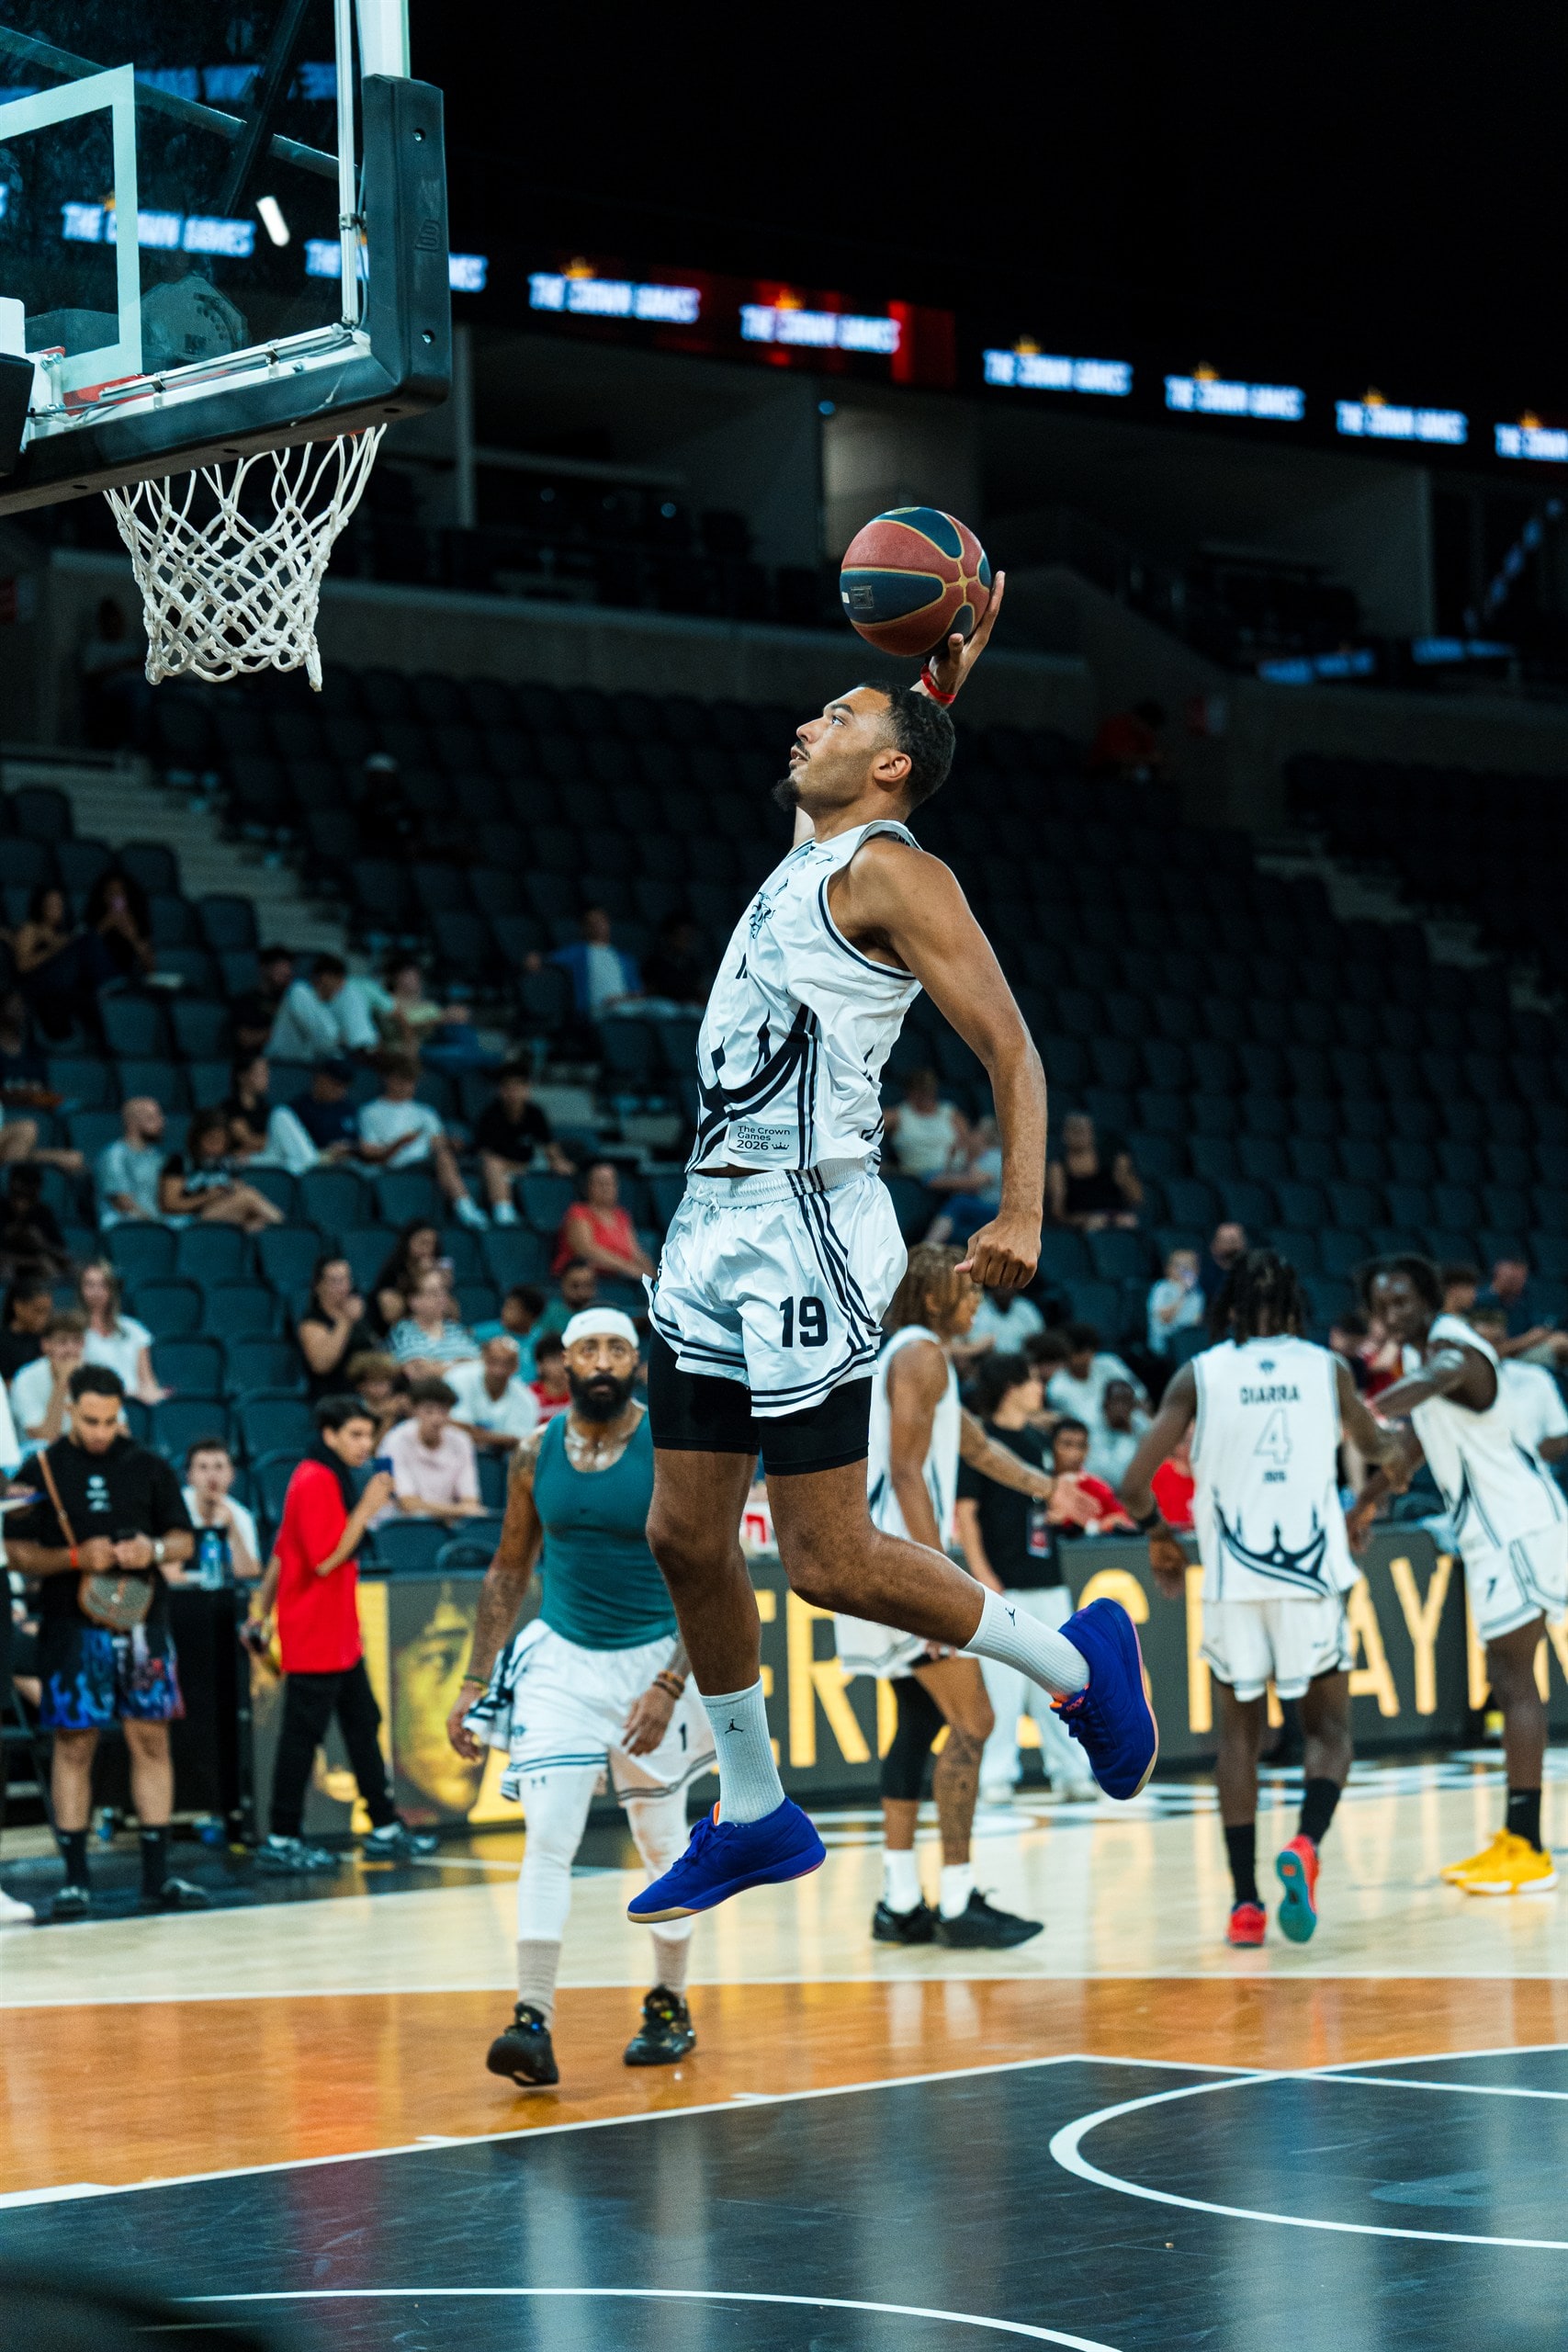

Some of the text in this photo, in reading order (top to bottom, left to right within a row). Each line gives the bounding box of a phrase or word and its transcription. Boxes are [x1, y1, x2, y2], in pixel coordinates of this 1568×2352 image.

[737, 1139, 769, 1150] 2026
[738, 1132, 771, 1140] Games
[779, 1295, 829, 1348] 19
[1253, 1408, 1292, 1465] 4
